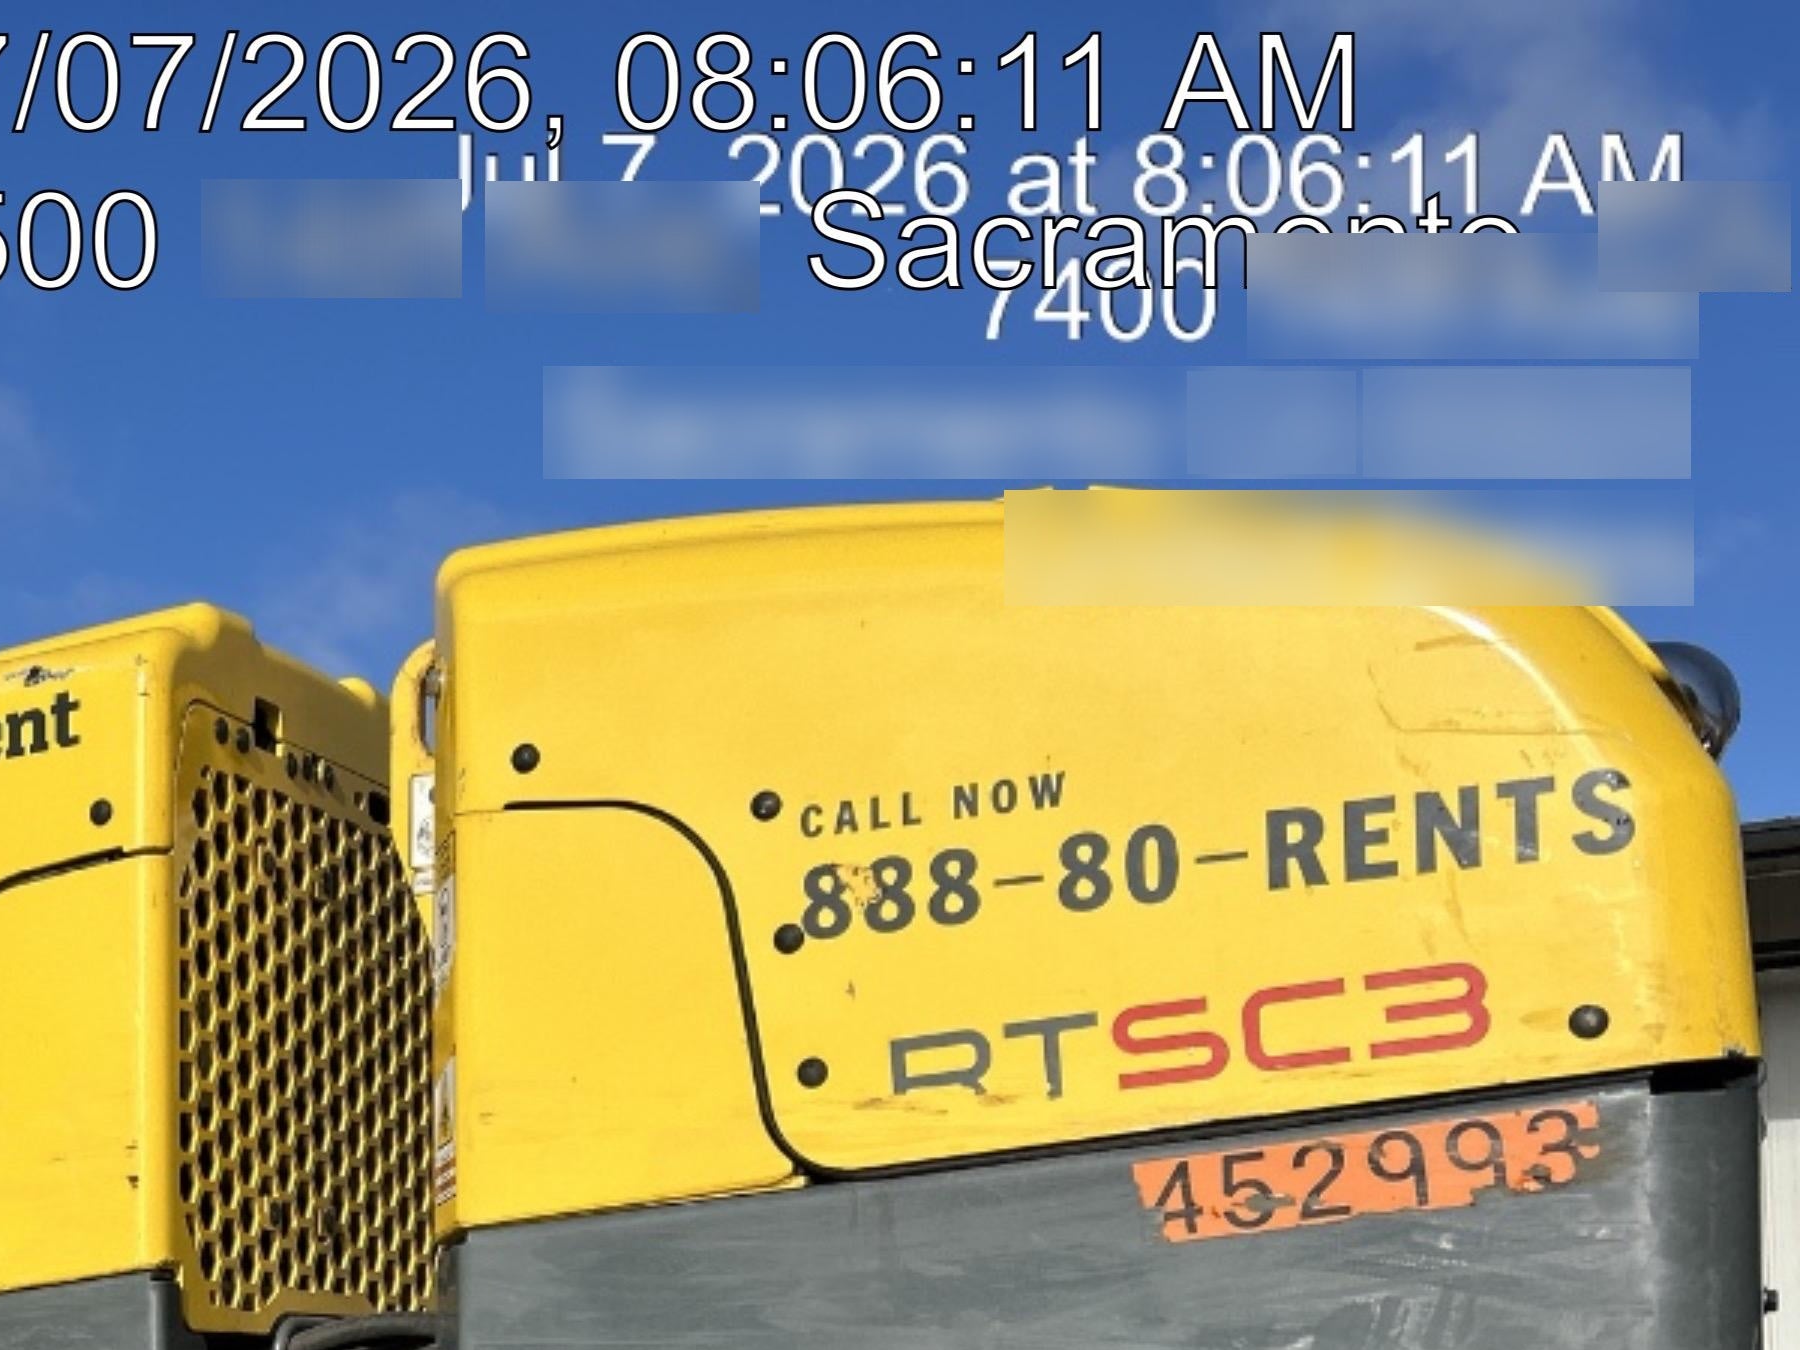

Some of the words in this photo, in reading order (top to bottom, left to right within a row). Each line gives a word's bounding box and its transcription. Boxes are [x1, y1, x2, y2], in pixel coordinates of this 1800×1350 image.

[800, 791, 922, 838] CALL
[953, 770, 1066, 819] NOW
[1155, 1109, 1584, 1234] 452993
